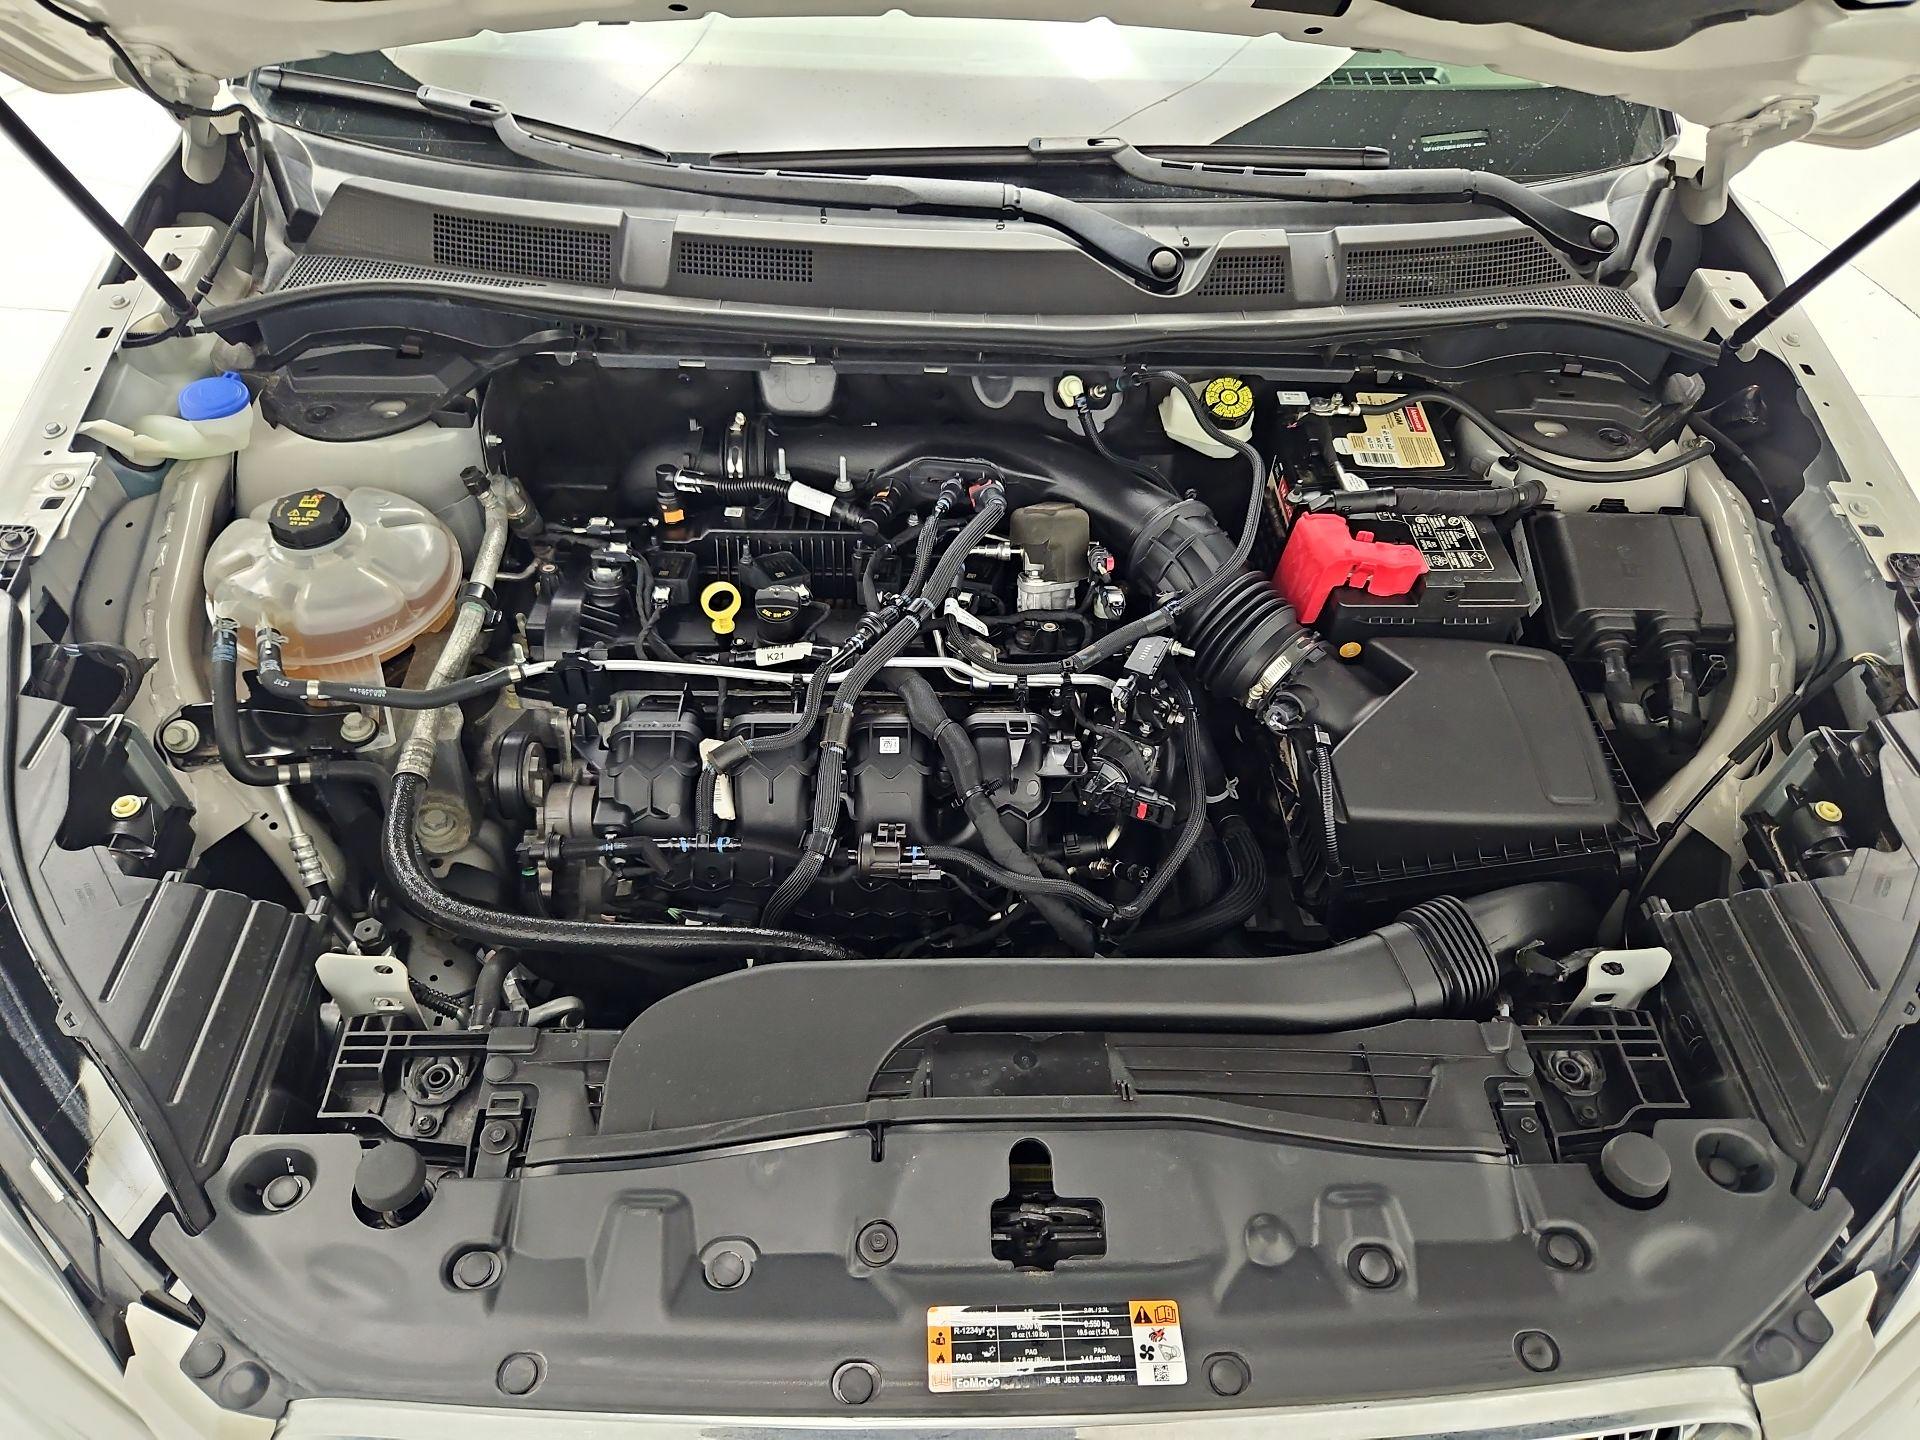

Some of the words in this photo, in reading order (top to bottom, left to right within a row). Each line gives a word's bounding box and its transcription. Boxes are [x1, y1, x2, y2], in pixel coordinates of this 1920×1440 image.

[766, 652, 784, 661] K21
[1101, 1320, 1111, 1329] kg
[953, 1326, 986, 1336] R-1234yf
[1024, 1348, 1038, 1356] PAG
[1093, 1346, 1107, 1354] PAG
[955, 1353, 973, 1361] PAG
[956, 1377, 1001, 1389] FoMoCo
[1045, 1376, 1061, 1384] SAE
